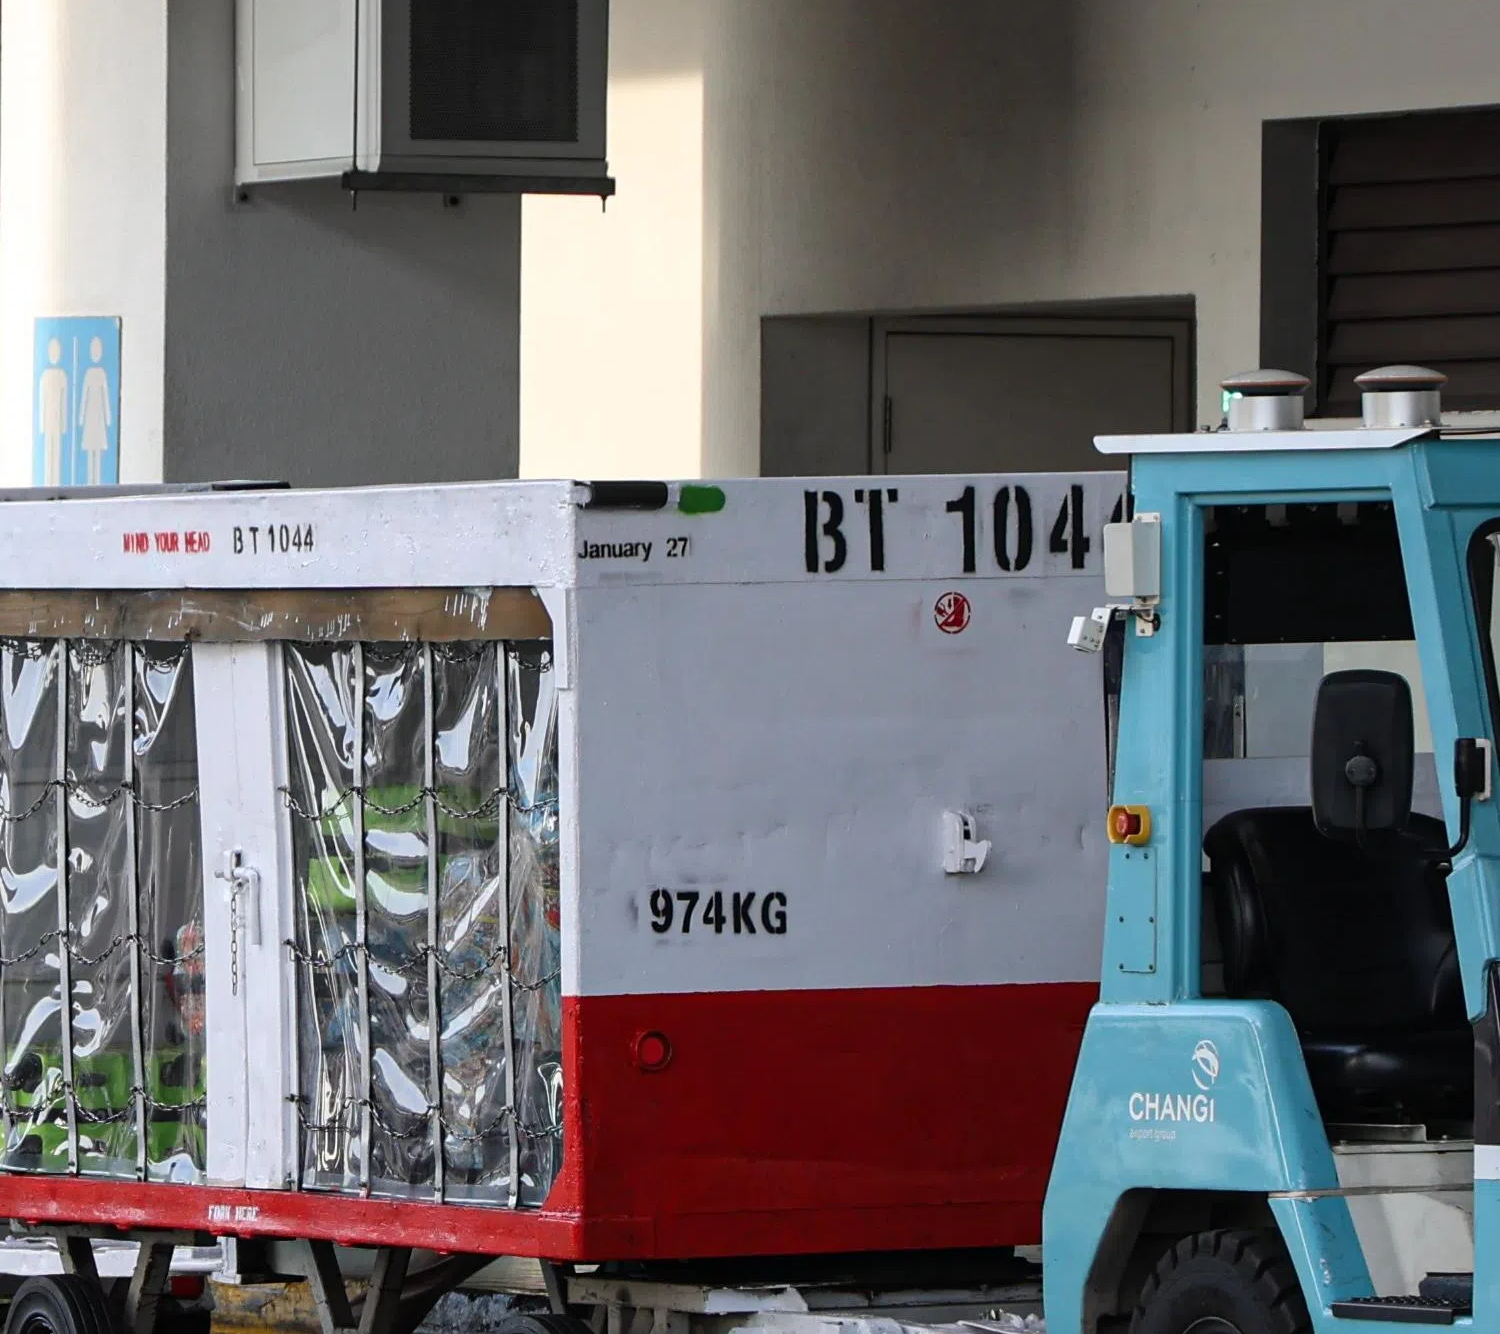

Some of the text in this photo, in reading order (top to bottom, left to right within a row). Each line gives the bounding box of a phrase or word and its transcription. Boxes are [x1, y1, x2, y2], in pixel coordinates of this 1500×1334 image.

[123, 530, 211, 553] MIND YOUR HEAD
[804, 488, 898, 573] BT
[577, 536, 689, 561] January 27
[650, 888, 787, 934] 974KG
[1128, 1092, 1215, 1123] CHANGI
